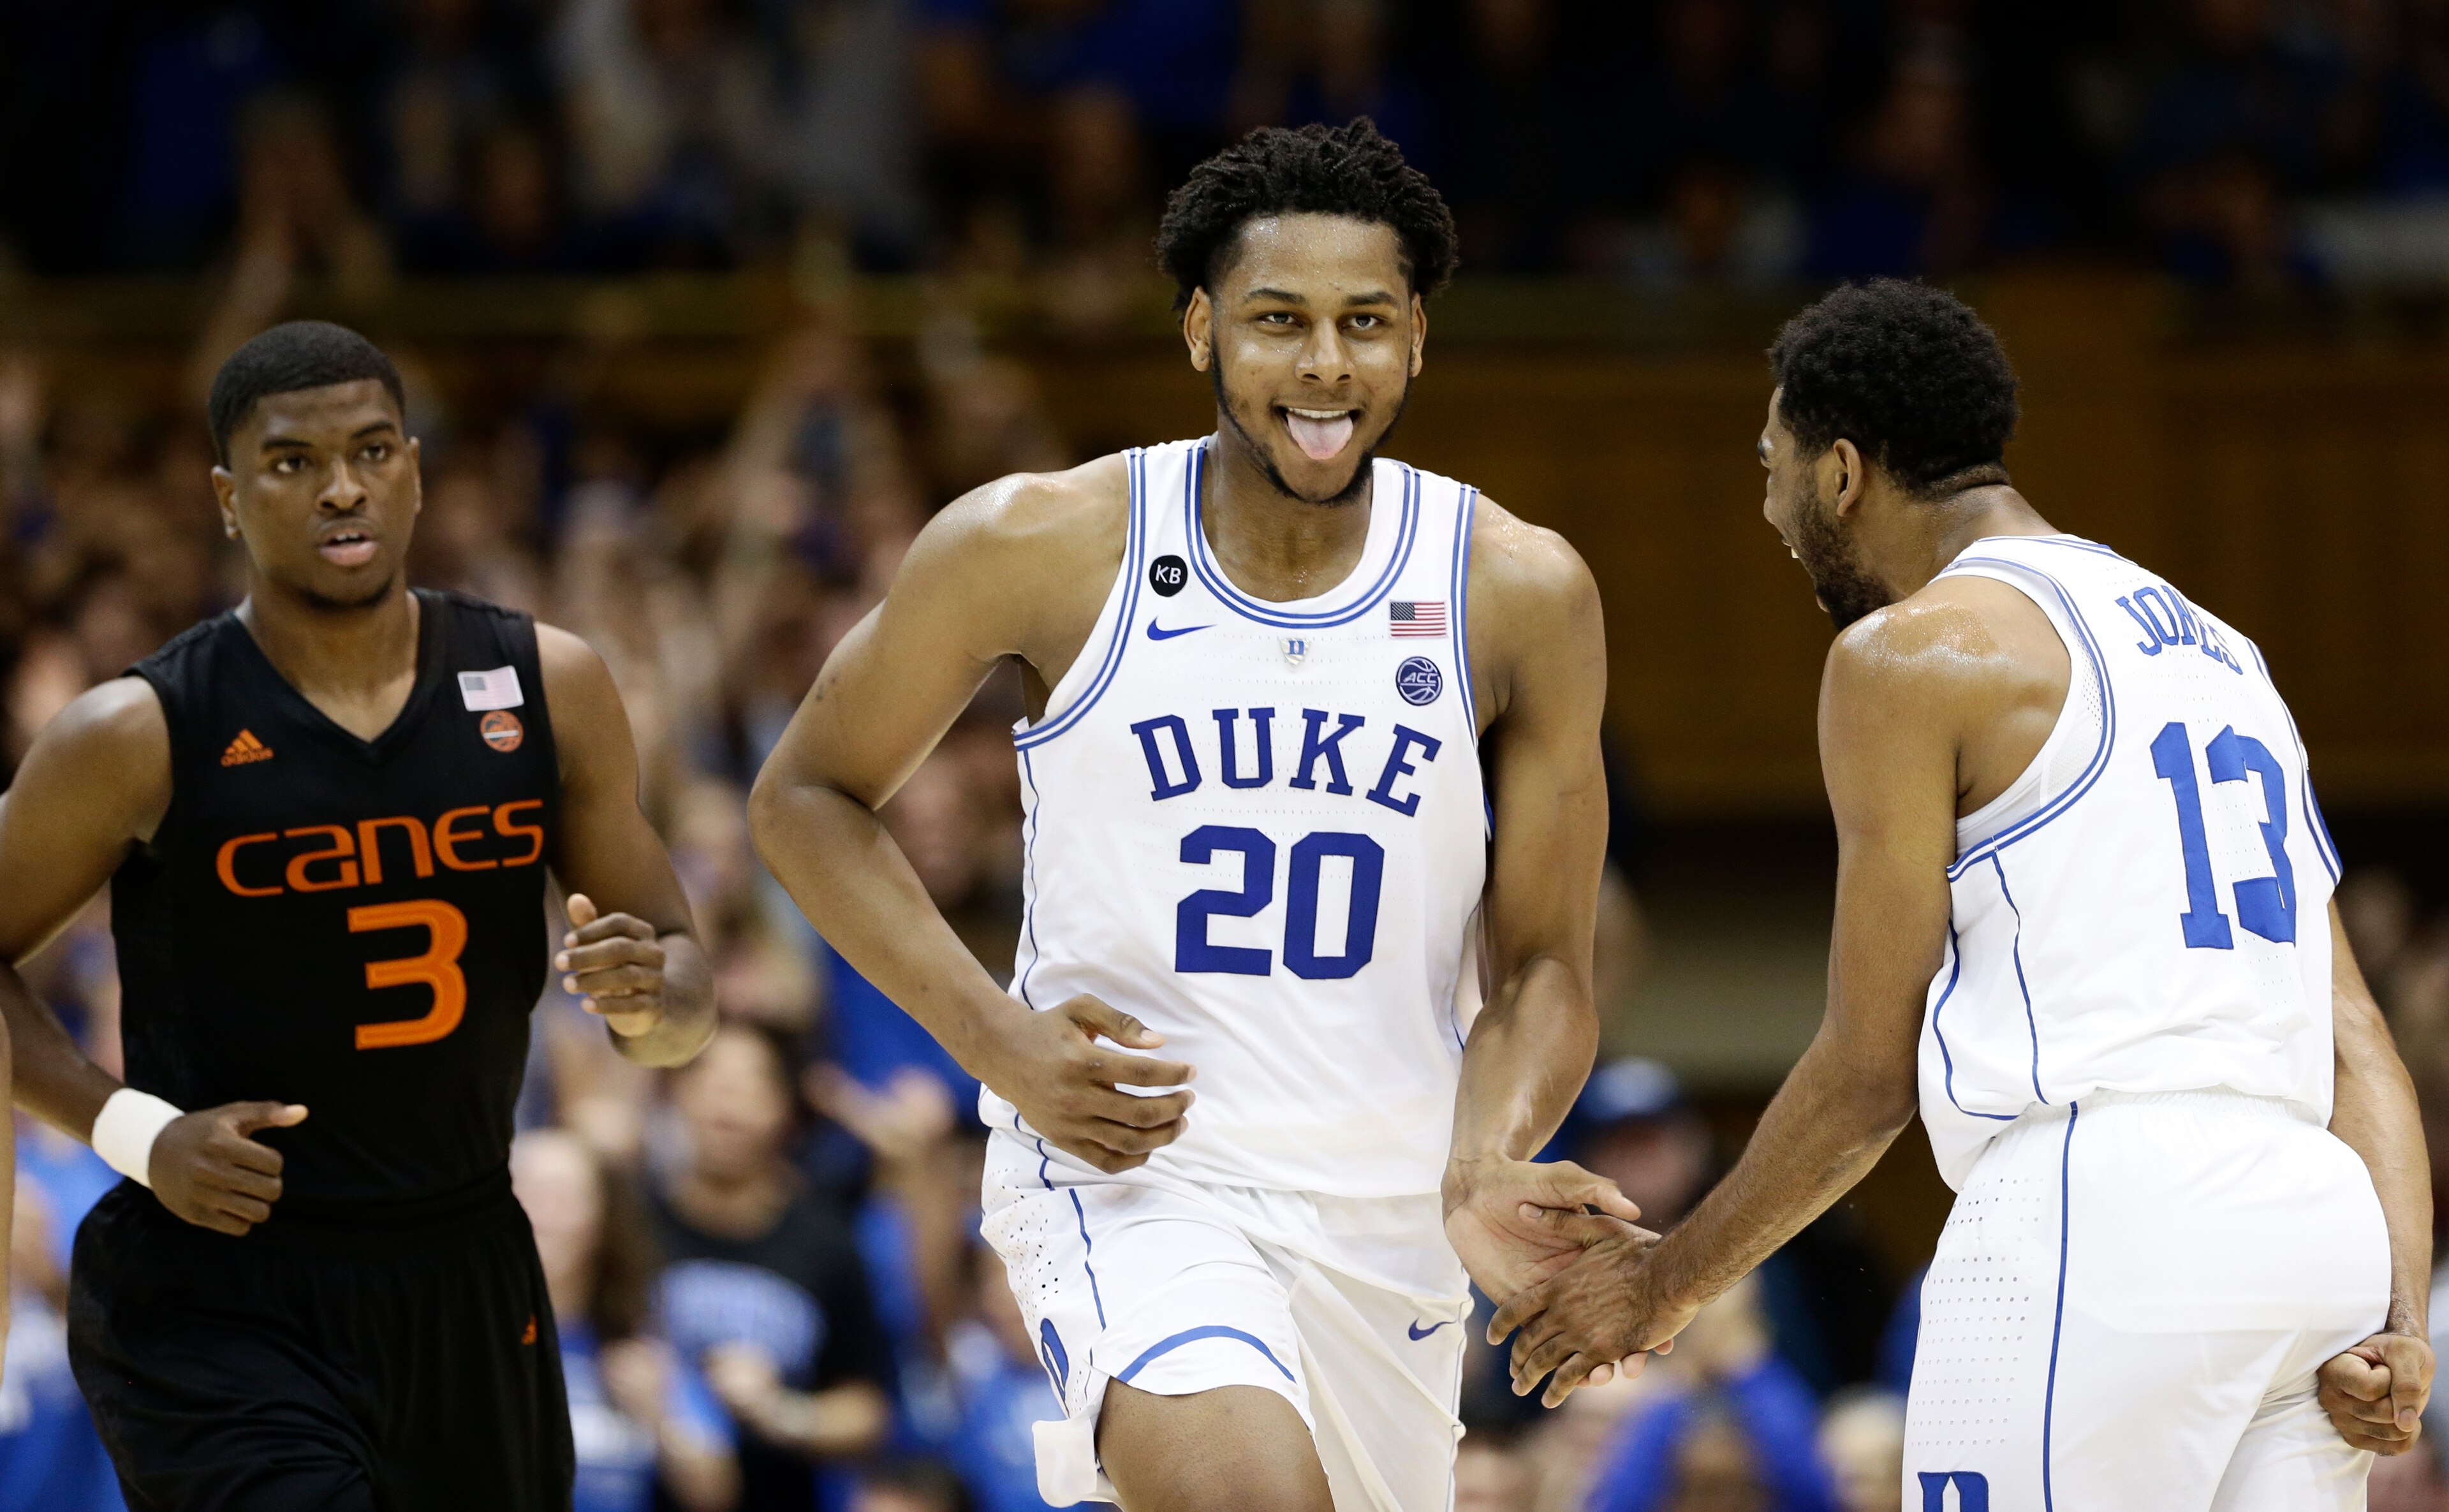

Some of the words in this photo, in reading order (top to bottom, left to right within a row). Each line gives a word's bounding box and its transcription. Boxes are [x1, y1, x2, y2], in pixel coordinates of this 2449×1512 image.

[1155, 564, 1182, 584] KB
[2114, 584, 2244, 675] JONES
[1403, 672, 1438, 684] ACC
[1130, 707, 1442, 818] DUKE
[2150, 722, 2297, 950] 13
[1175, 825, 1385, 980] 20
[347, 899, 469, 1051] 3
